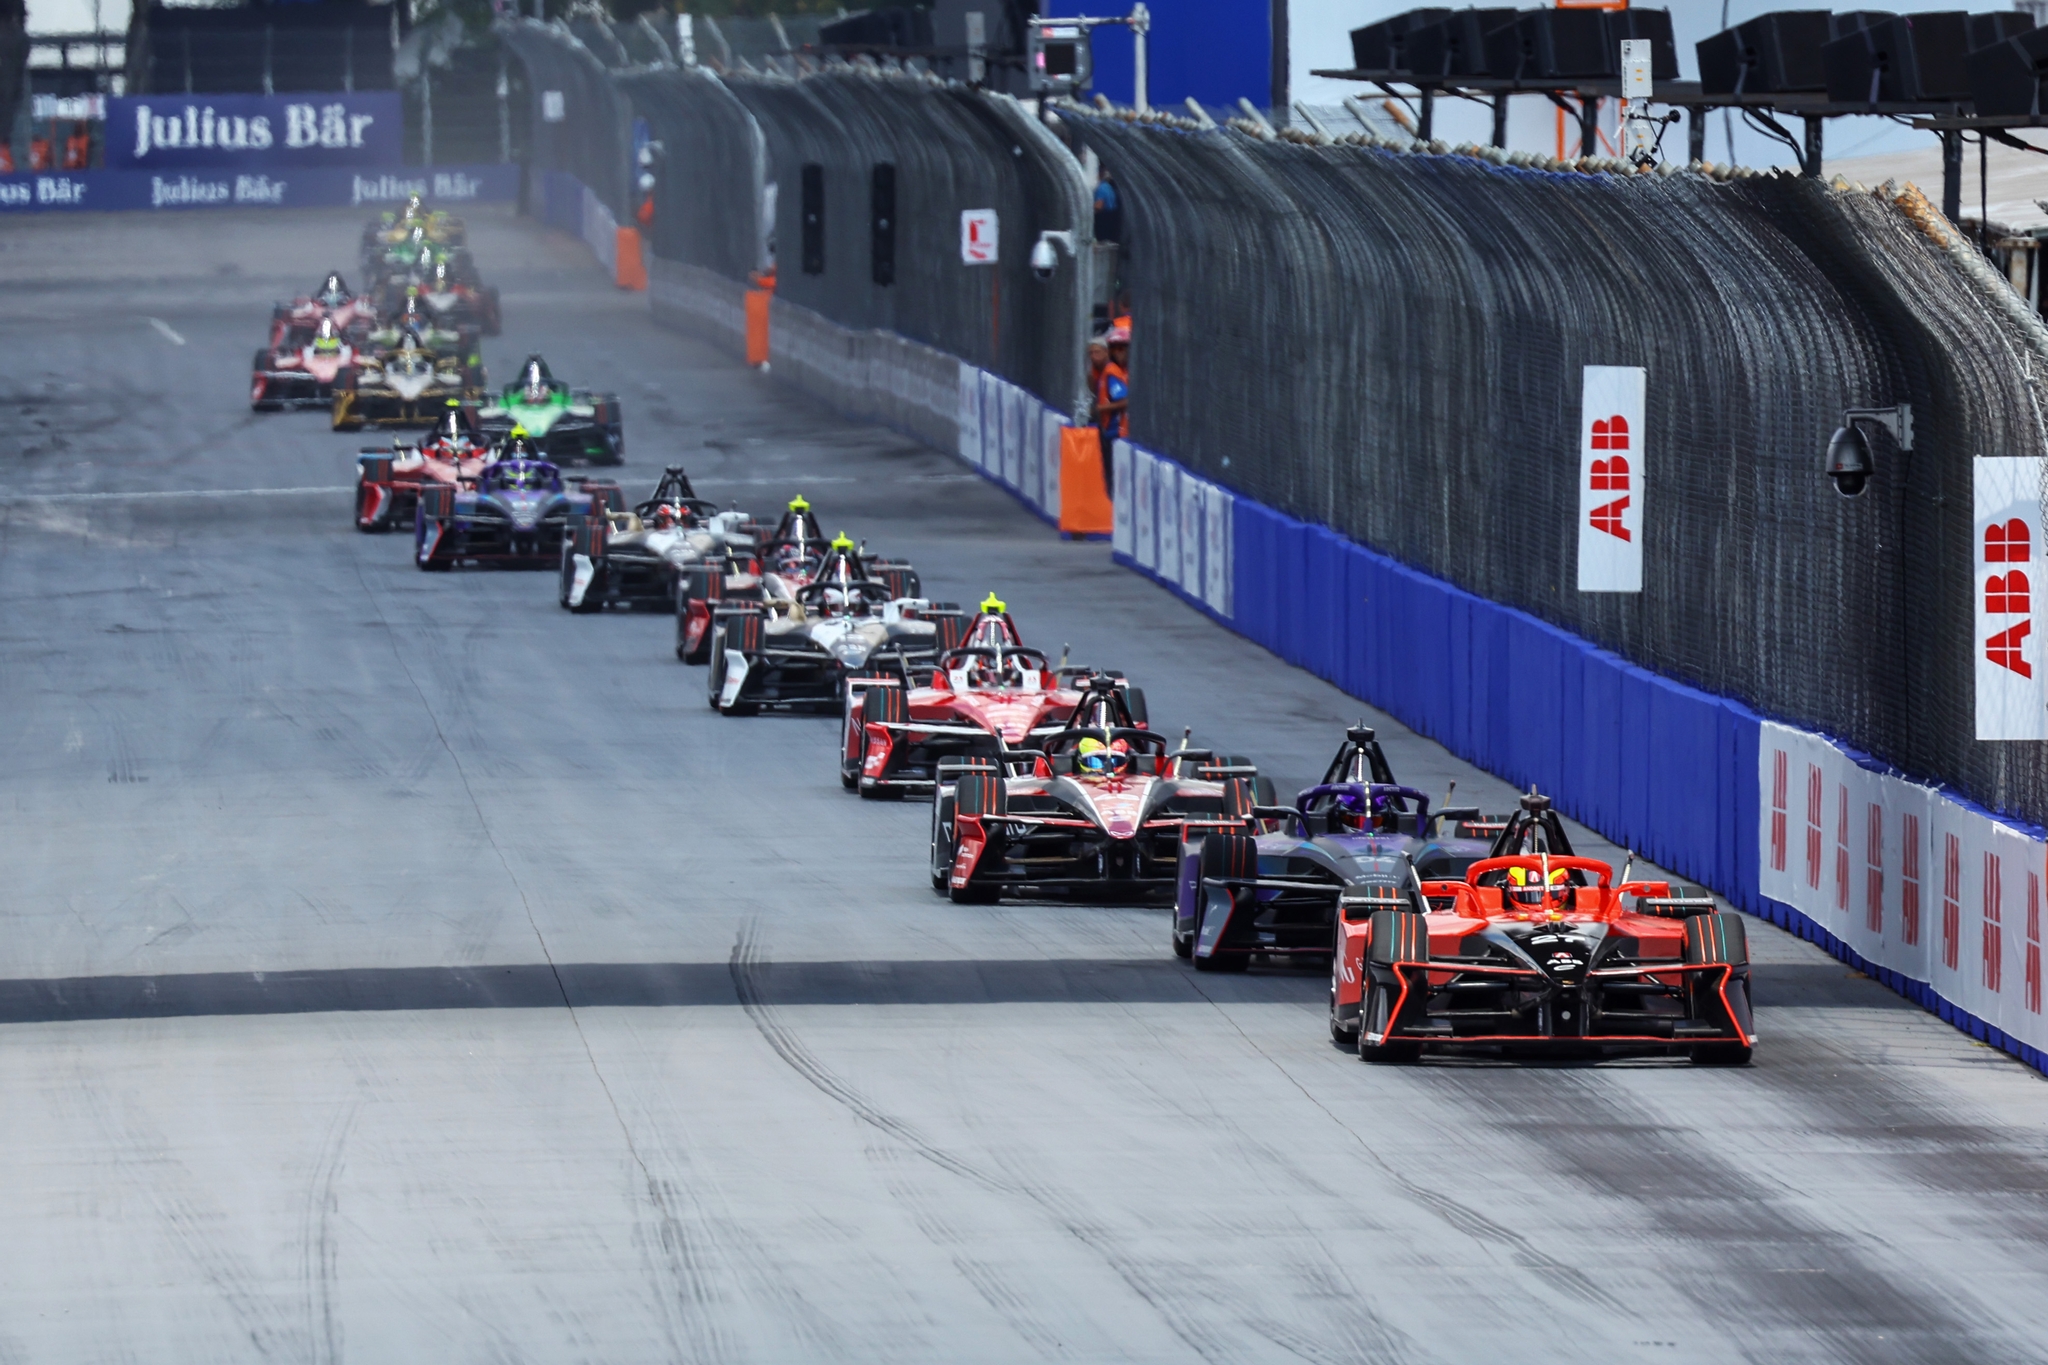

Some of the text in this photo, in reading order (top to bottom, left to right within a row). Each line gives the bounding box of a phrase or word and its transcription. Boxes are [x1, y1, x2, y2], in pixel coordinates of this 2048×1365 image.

[134, 104, 273, 158] Julius
[285, 102, 374, 148] Bär
[152, 174, 287, 207] Julius Bär
[353, 174, 428, 206] Julius
[1590, 414, 1632, 543] ABB
[1984, 517, 2032, 680] ABB
[1530, 933, 1586, 945] 27
